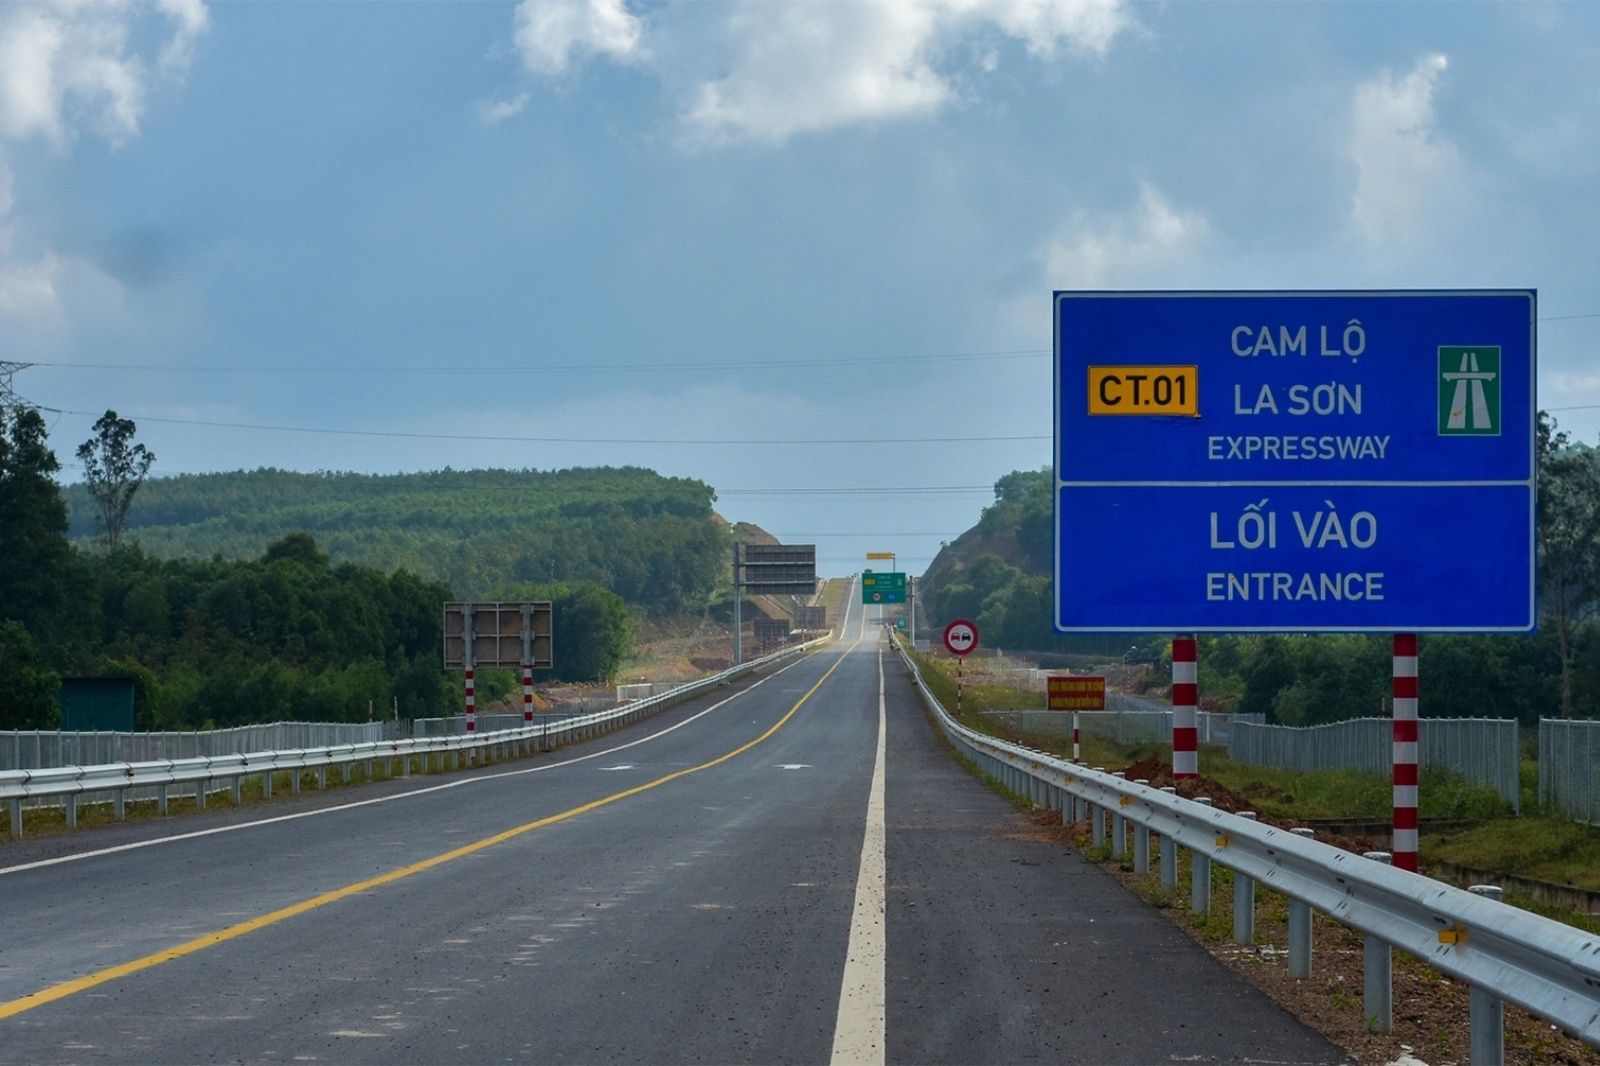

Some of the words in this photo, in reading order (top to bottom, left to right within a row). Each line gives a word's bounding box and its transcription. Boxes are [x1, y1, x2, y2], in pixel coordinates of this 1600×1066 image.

[1231, 326, 1306, 356] CAM
[1321, 319, 1366, 363] LỘ
[1099, 375, 1187, 406] CT.01
[1235, 384, 1278, 415] LA
[1288, 381, 1361, 415] SƠN
[1208, 435, 1390, 460] EXPRESSWAY
[1210, 498, 1276, 549] LỐI
[1293, 500, 1377, 549] VÀO
[1207, 573, 1384, 600] ENTRANCE
